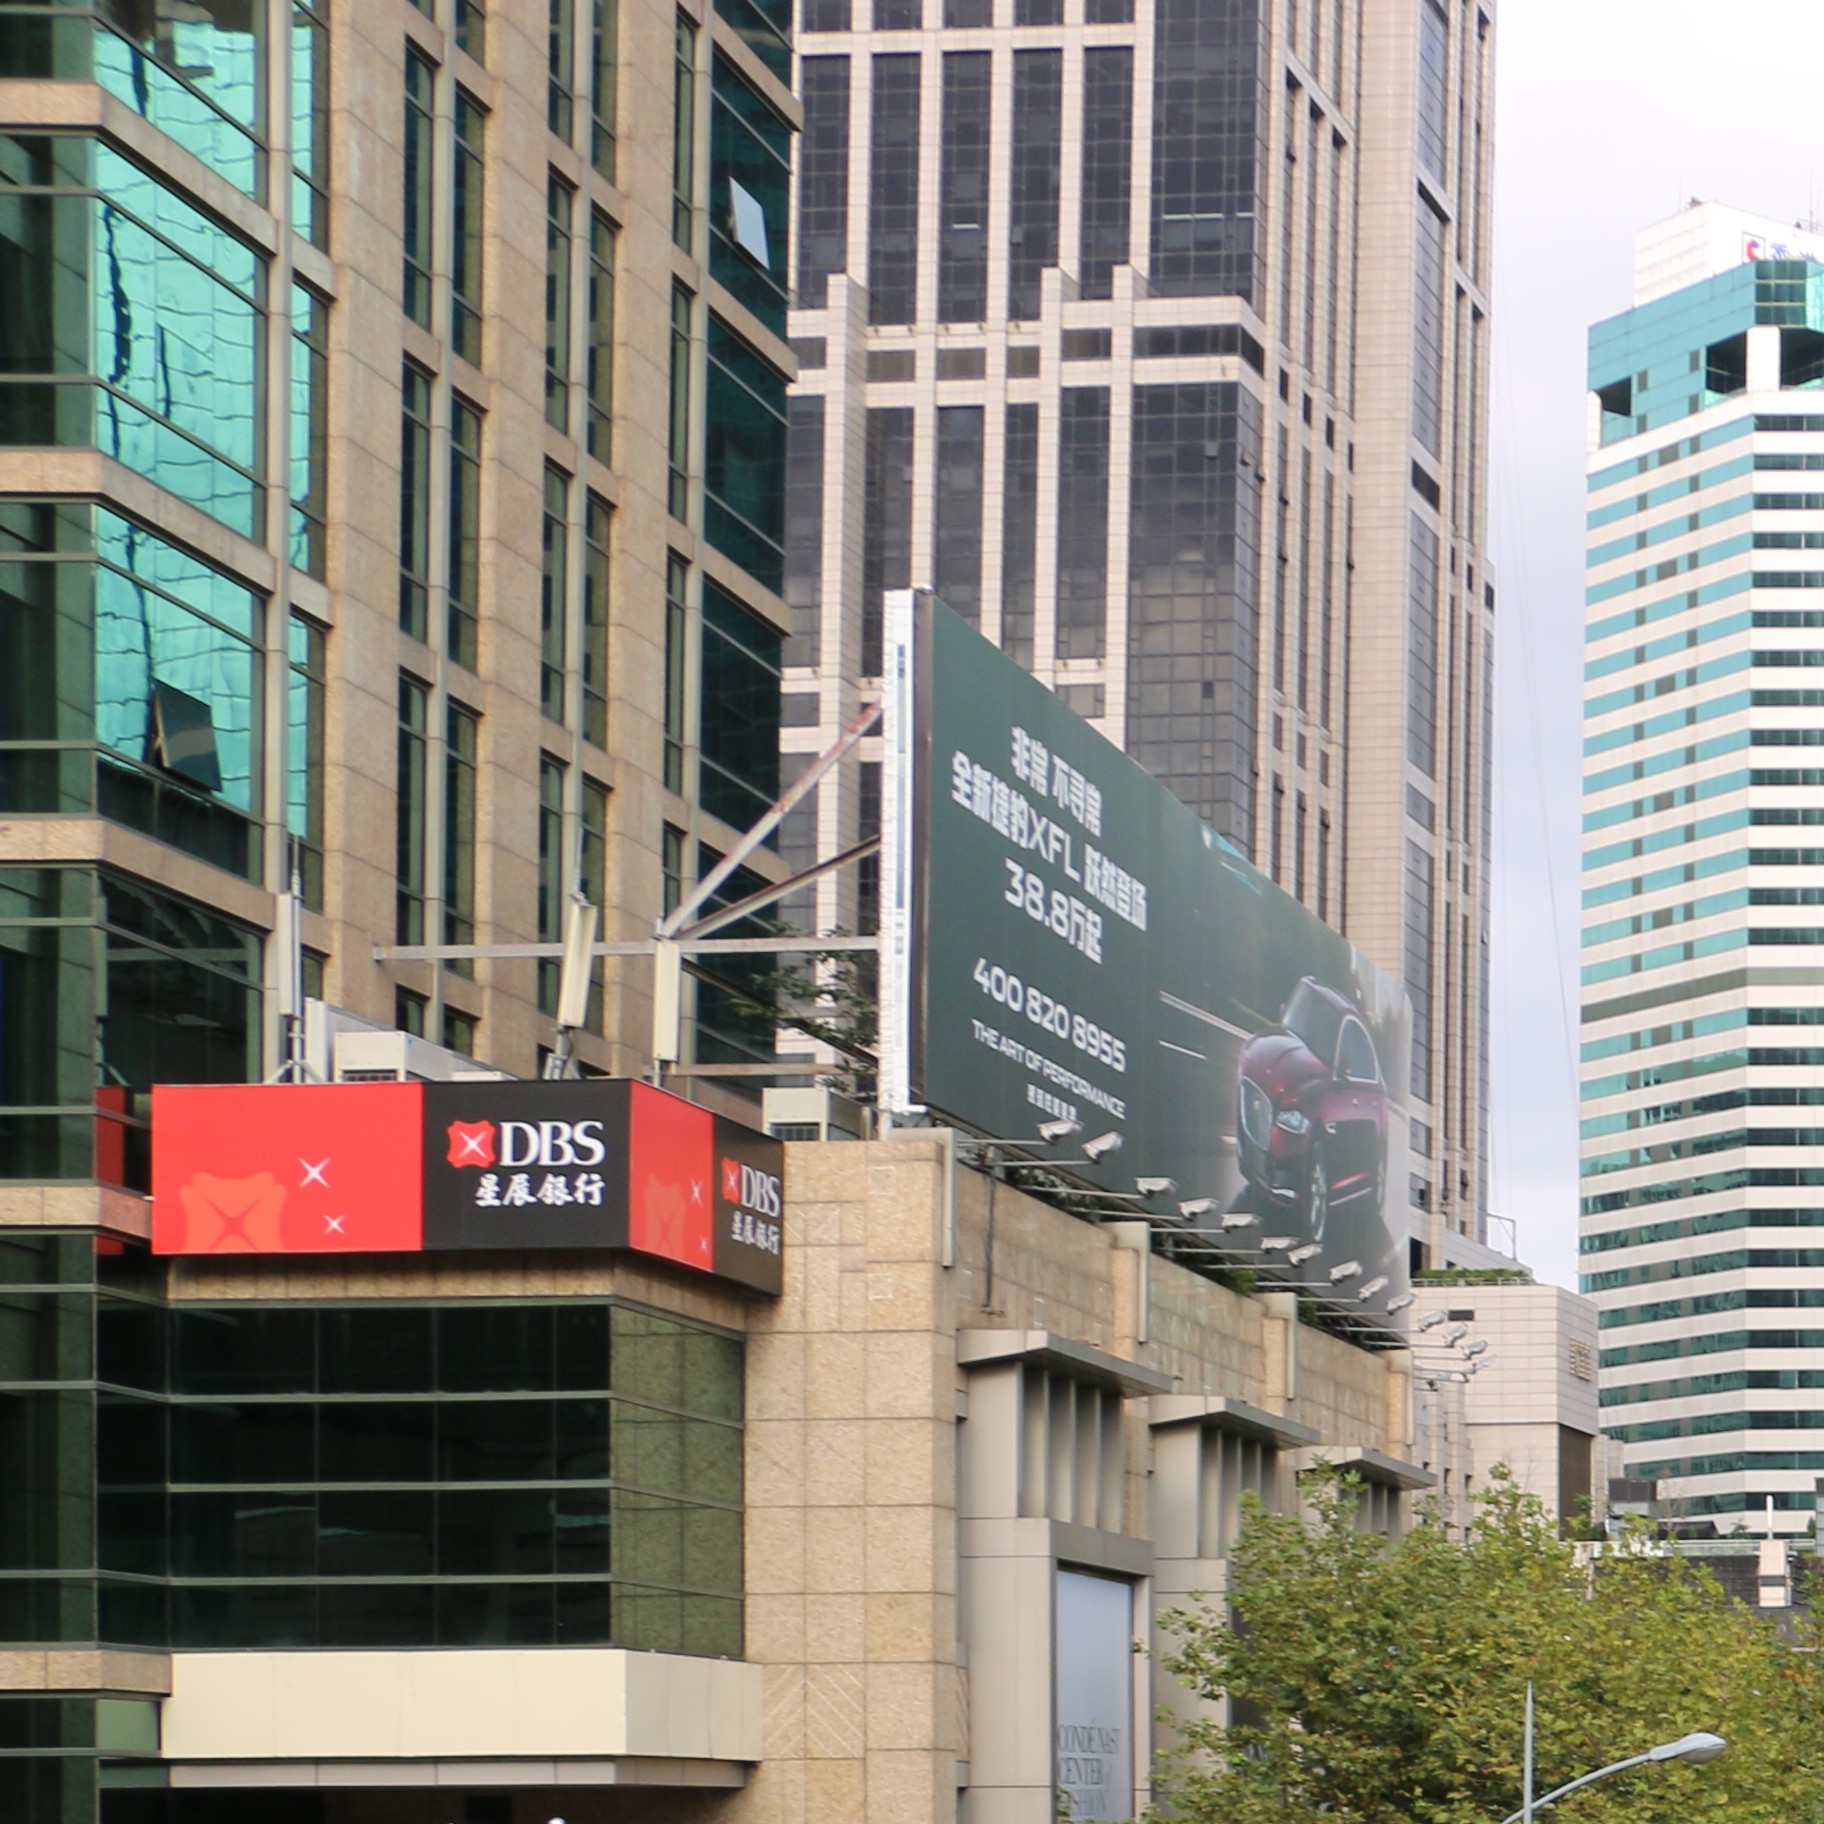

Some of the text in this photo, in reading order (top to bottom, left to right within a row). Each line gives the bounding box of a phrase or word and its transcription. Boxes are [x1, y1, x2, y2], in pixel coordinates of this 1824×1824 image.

[973, 957, 1126, 1073] 400 820 8955
[972, 1018, 1000, 1050] THE
[1000, 1034, 1026, 1064] ART
[1025, 1049, 1044, 1072] OF
[1043, 1059, 1126, 1120] PERFORMANCE
[499, 1121, 606, 1167] DBS
[741, 1165, 781, 1217] DBS
